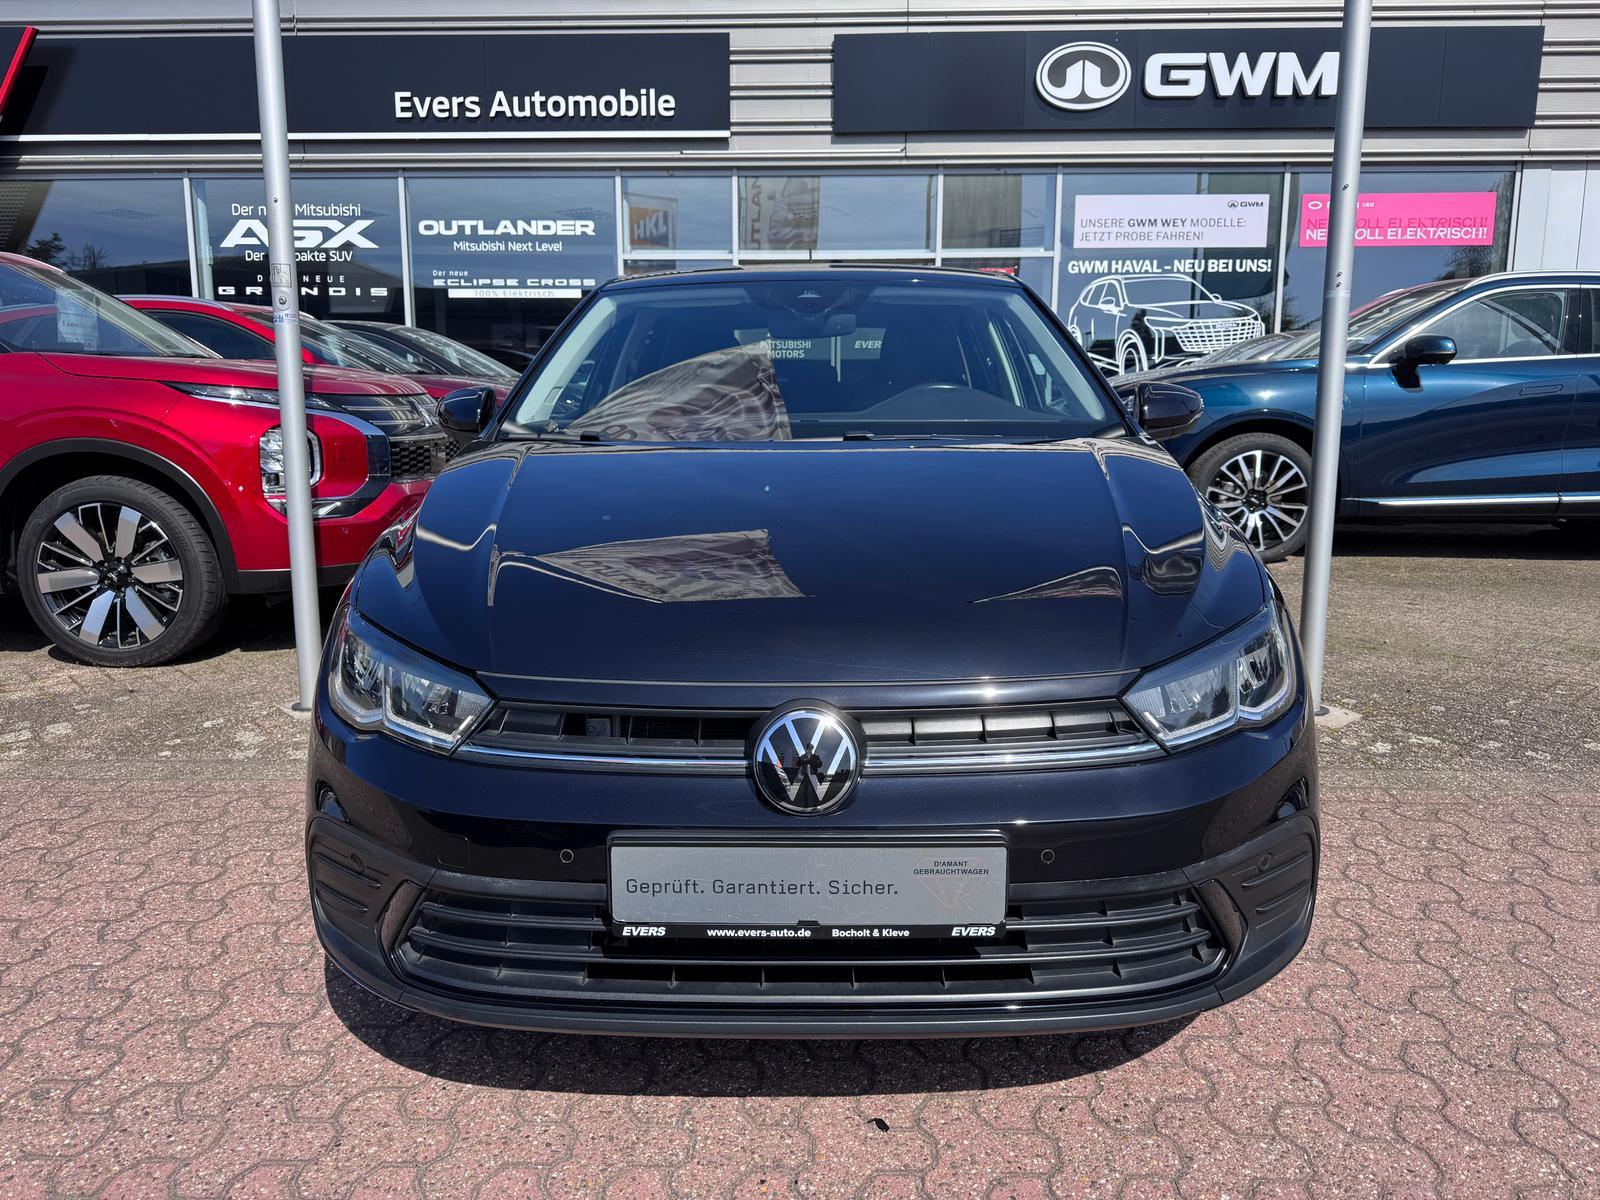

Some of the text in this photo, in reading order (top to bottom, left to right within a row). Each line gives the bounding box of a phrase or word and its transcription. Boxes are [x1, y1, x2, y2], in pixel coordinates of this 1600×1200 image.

[1144, 51, 1340, 97] GWM
[394, 88, 676, 119] Evers Automobile
[231, 204, 254, 216] Der
[295, 203, 362, 217] Mitsubishi
[418, 219, 596, 236] OUTLANDER
[1080, 217, 1247, 229] UNSERE GWM WEY MODELLE:
[1305, 216, 1488, 230] NE OLL ELEKTRISCH!
[219, 219, 380, 249] ASX
[1079, 231, 1204, 242] JETZT PROBE FAHREN!
[1305, 227, 1488, 241] NE OLL ELEKTRISCH!
[453, 241, 563, 252] Mitsubishi Next Level
[245, 250, 265, 262] Der
[330, 250, 353, 262] SUV
[1067, 260, 1108, 274] GWM
[1111, 260, 1162, 273] HAVAL
[1173, 260, 1205, 273] NEU
[1208, 260, 1233, 273] BEI
[1235, 259, 1272, 272] UNS!
[302, 275, 345, 283] NEUE
[433, 278, 596, 286] ECLIPSE CROSS
[218, 286, 388, 297] GRNDIS
[474, 290, 499, 298] 100%
[760, 340, 811, 349] MITSUBISHI
[767, 350, 805, 359] MOTORS
[933, 860, 968, 868] D'AMANT
[625, 878, 898, 898] Geprüft. Garantiert. Sicher.
[622, 926, 996, 937] EVERS www.evers-auto.de Bocholt & Kleve EVERS
